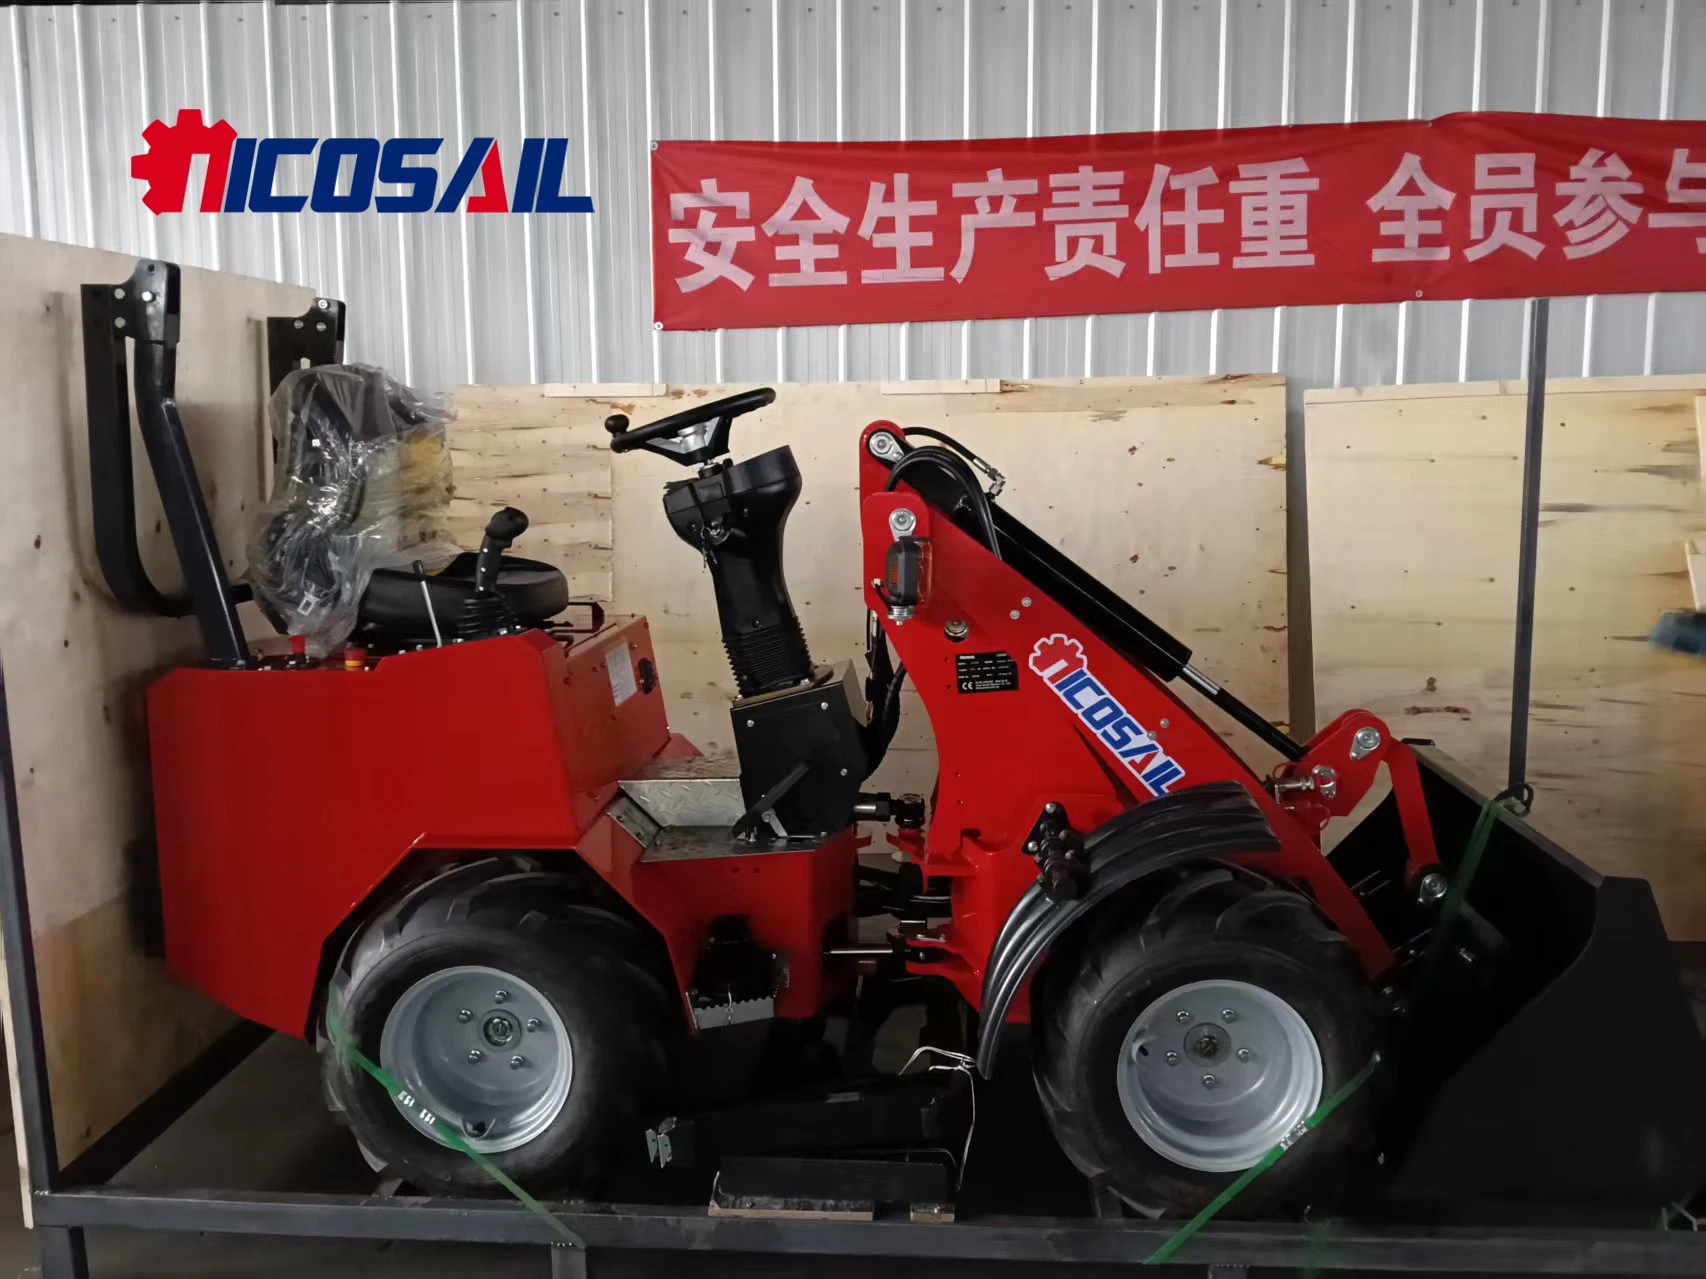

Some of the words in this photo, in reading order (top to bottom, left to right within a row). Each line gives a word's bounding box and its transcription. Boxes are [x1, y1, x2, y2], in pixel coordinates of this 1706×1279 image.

[668, 157, 1320, 293] 安全生产责任重
[1366, 148, 1706, 262] 全员参与
